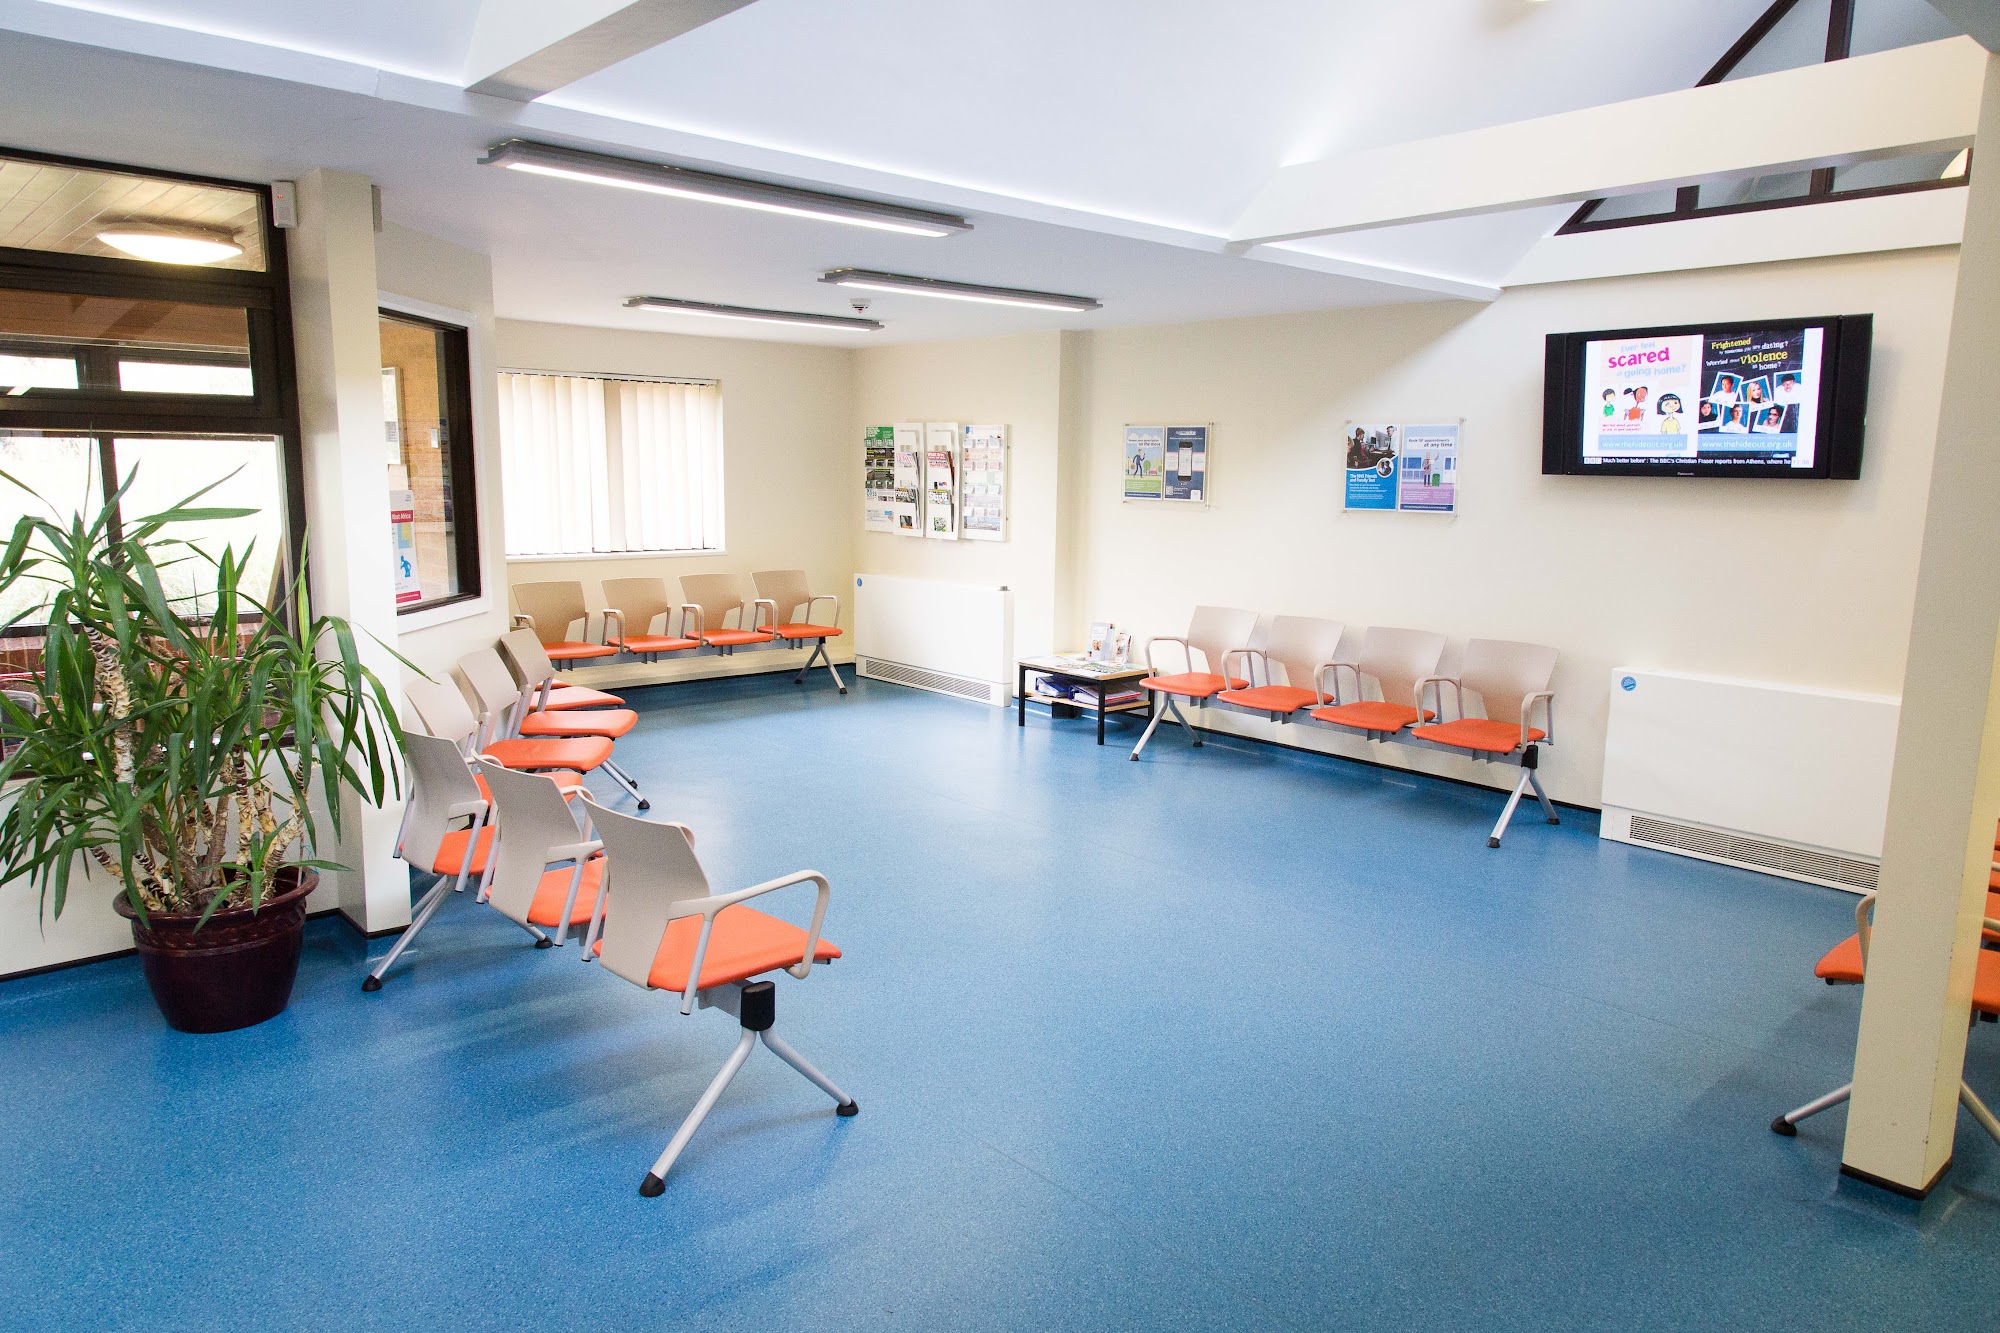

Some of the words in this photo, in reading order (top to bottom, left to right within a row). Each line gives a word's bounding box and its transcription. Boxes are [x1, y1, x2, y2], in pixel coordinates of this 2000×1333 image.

[1641, 341, 1655, 349] feel
[1711, 337, 1752, 350] Frightened
[1761, 341, 1789, 350] dating?
[1608, 347, 1670, 369] scared
[1759, 361, 1781, 371] home?
[1624, 367, 1651, 378] going
[1654, 364, 1686, 375] home?
[1601, 440, 1683, 449] www.thehideout.org.uk
[1701, 440, 1793, 449] www.thehideout.org.uk
